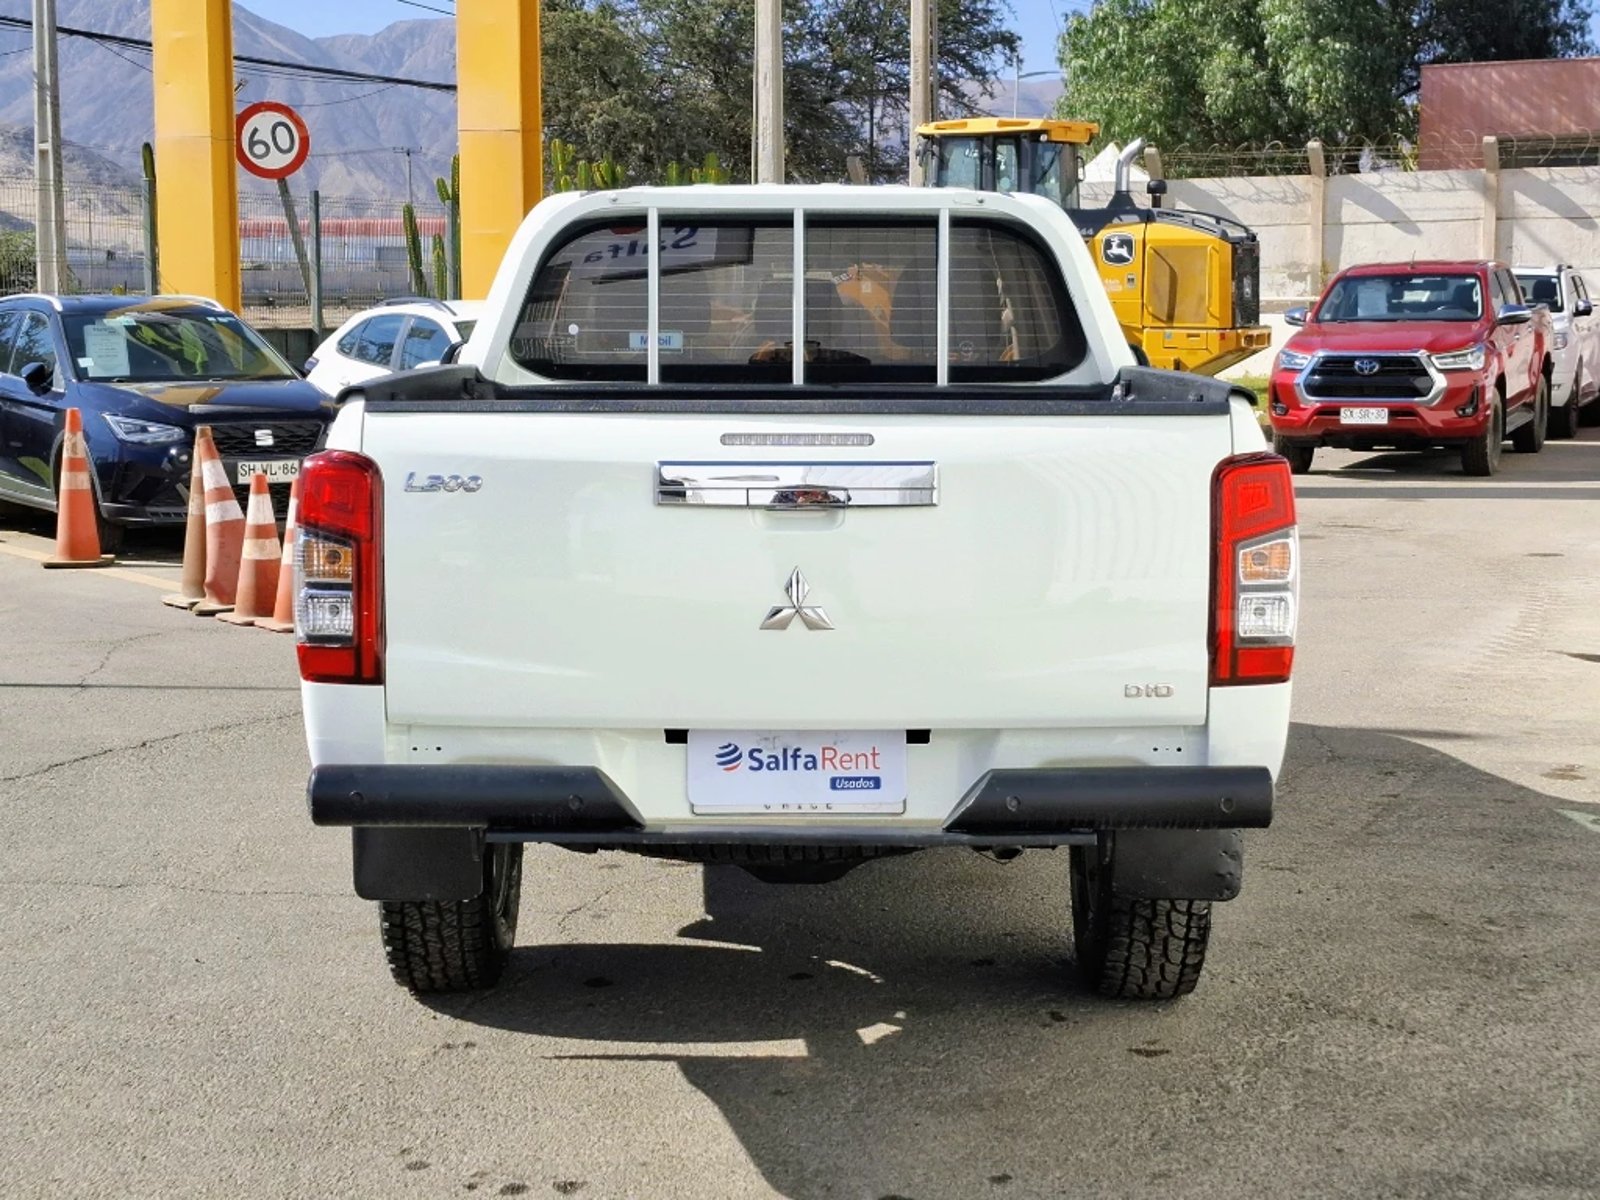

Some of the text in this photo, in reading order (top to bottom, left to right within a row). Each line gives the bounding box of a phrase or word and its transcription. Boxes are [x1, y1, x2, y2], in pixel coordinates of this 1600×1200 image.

[247, 120, 296, 160] 60
[639, 335, 672, 347] Mbil
[403, 471, 483, 493] L200
[747, 746, 881, 772] SalfaRent
[835, 777, 876, 789] Usados
